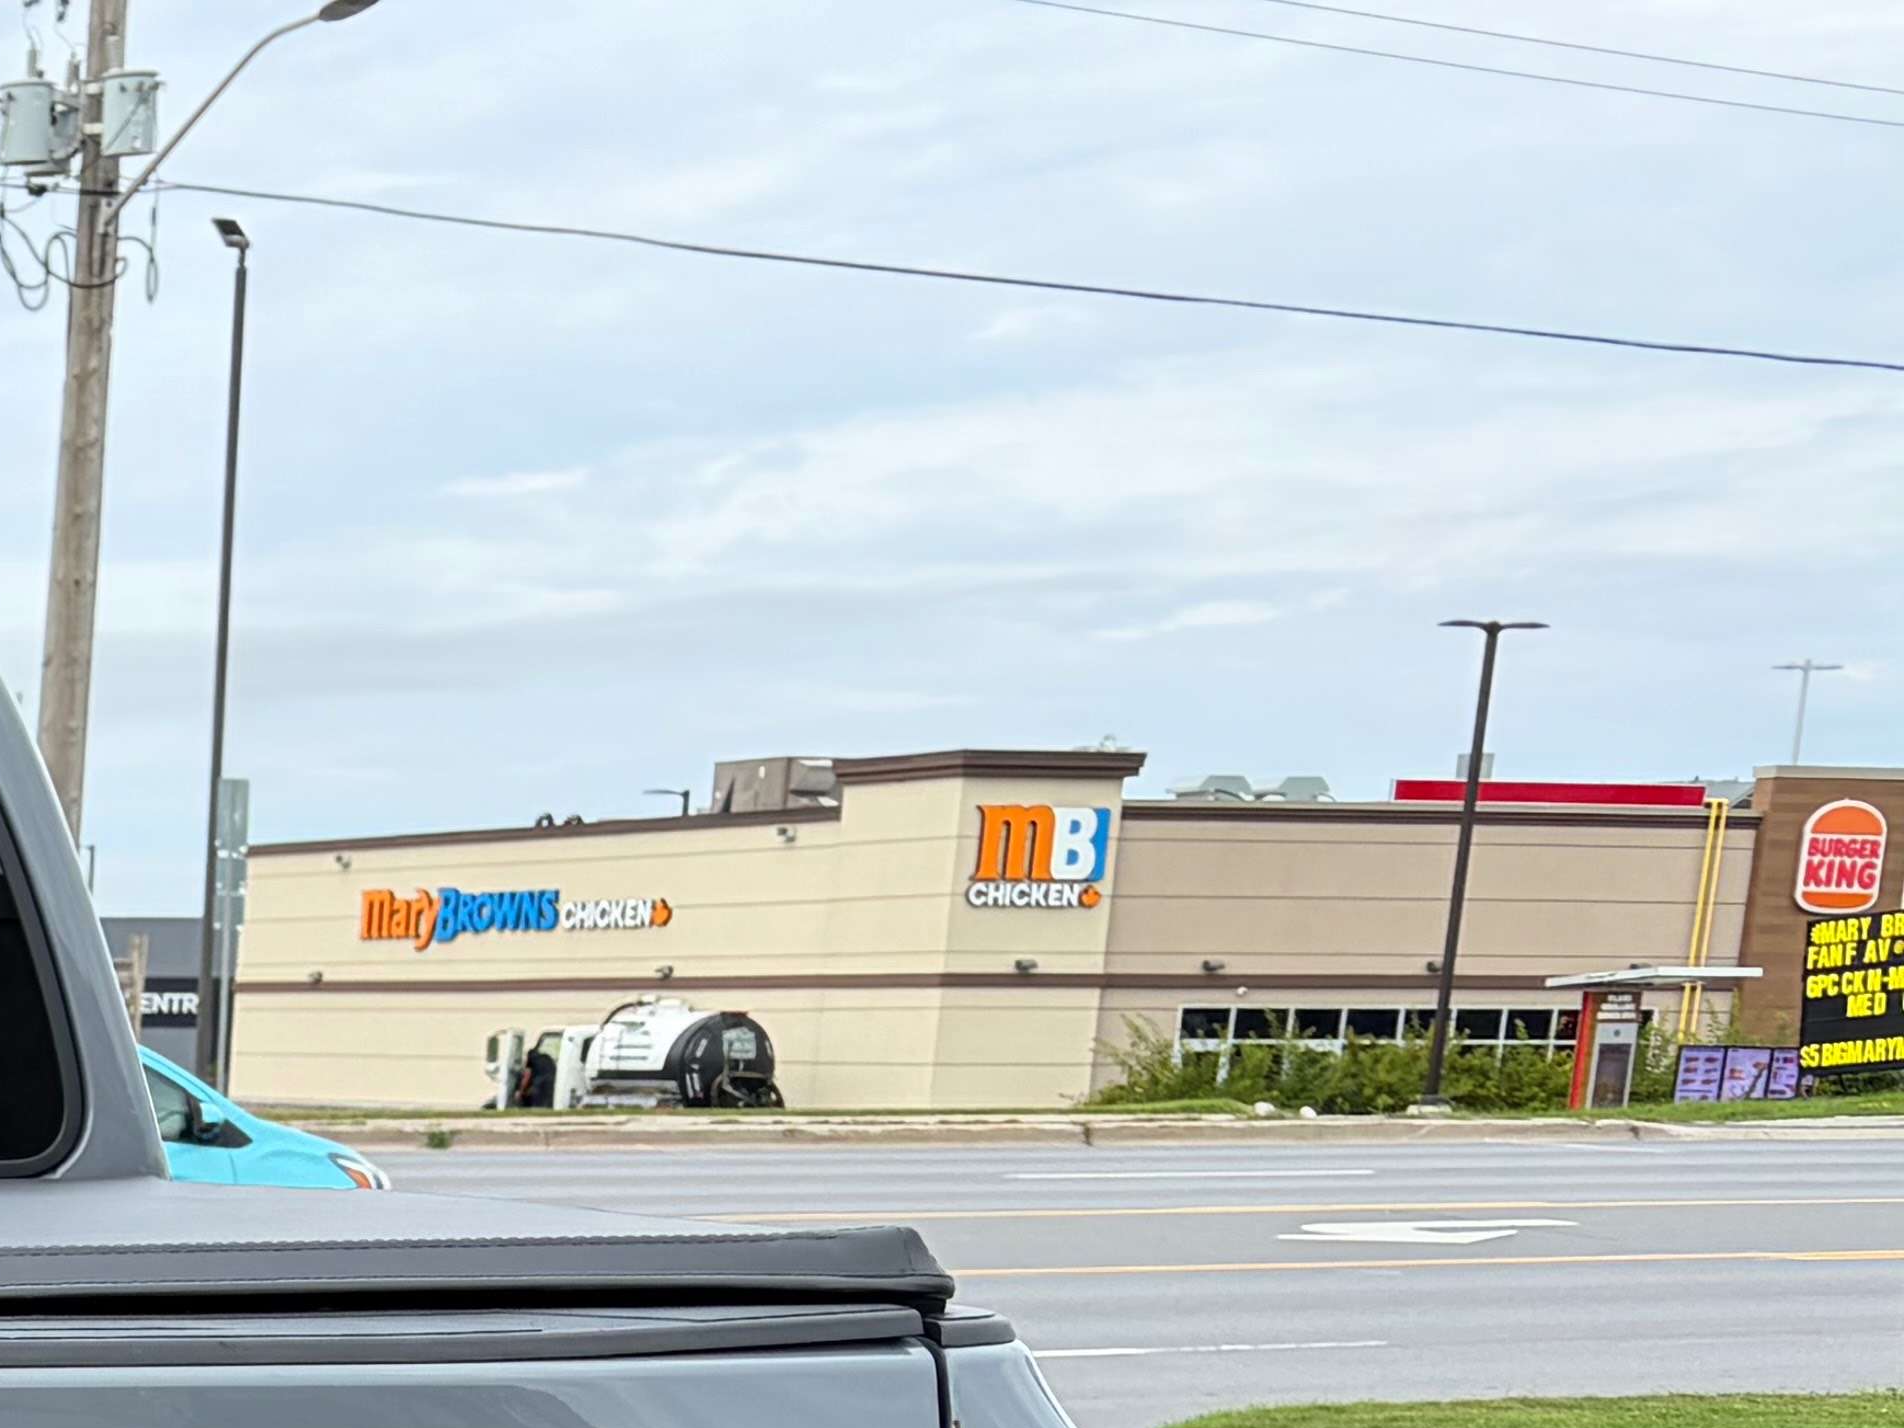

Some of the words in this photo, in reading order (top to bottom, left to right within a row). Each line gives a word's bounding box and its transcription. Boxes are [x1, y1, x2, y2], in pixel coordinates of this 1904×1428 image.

[975, 804, 1100, 882] MB
[1808, 837, 1881, 859] BURGER
[1803, 859, 1877, 890] KING
[967, 882, 1080, 908] CHICKEN
[561, 901, 654, 930] CHICKEN
